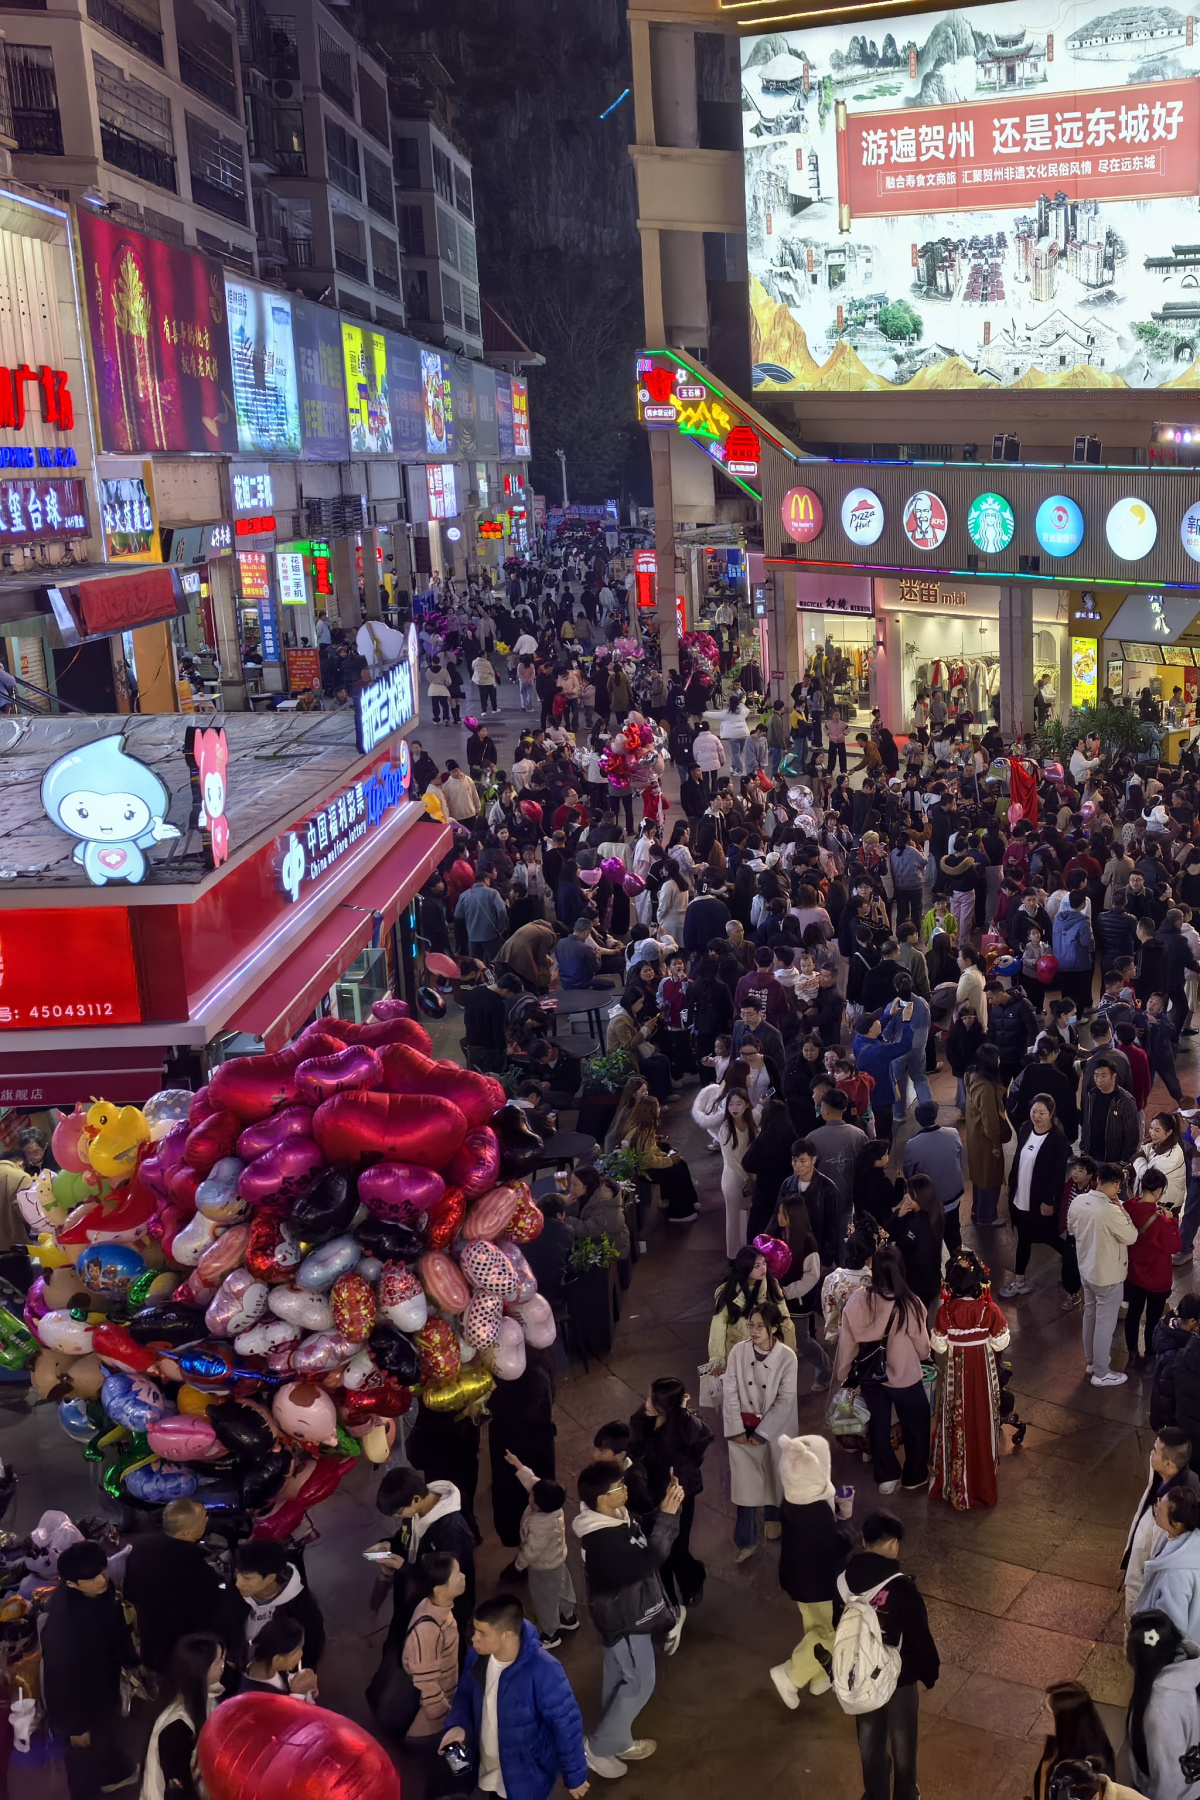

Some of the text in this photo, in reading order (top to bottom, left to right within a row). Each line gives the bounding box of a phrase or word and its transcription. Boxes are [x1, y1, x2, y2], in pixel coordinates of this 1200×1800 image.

[861, 120, 975, 166] 游遍贺州
[992, 101, 1185, 155] 还是远东城好
[885, 155, 1156, 189] 融合寿食文商旅 汇聚贺州非遗文化民俗风情 尽在远东城
[854, 520, 872, 532] Hut
[930, 518, 946, 526] KFC
[290, 556, 304, 598] 花姐二手机
[826, 597, 848, 610] 幻镜
[942, 591, 967, 607] midi
[307, 781, 365, 858] 中国福利彩票
[310, 820, 367, 880] China welfare lottery
[29, 1002, 114, 1019] 45043112
